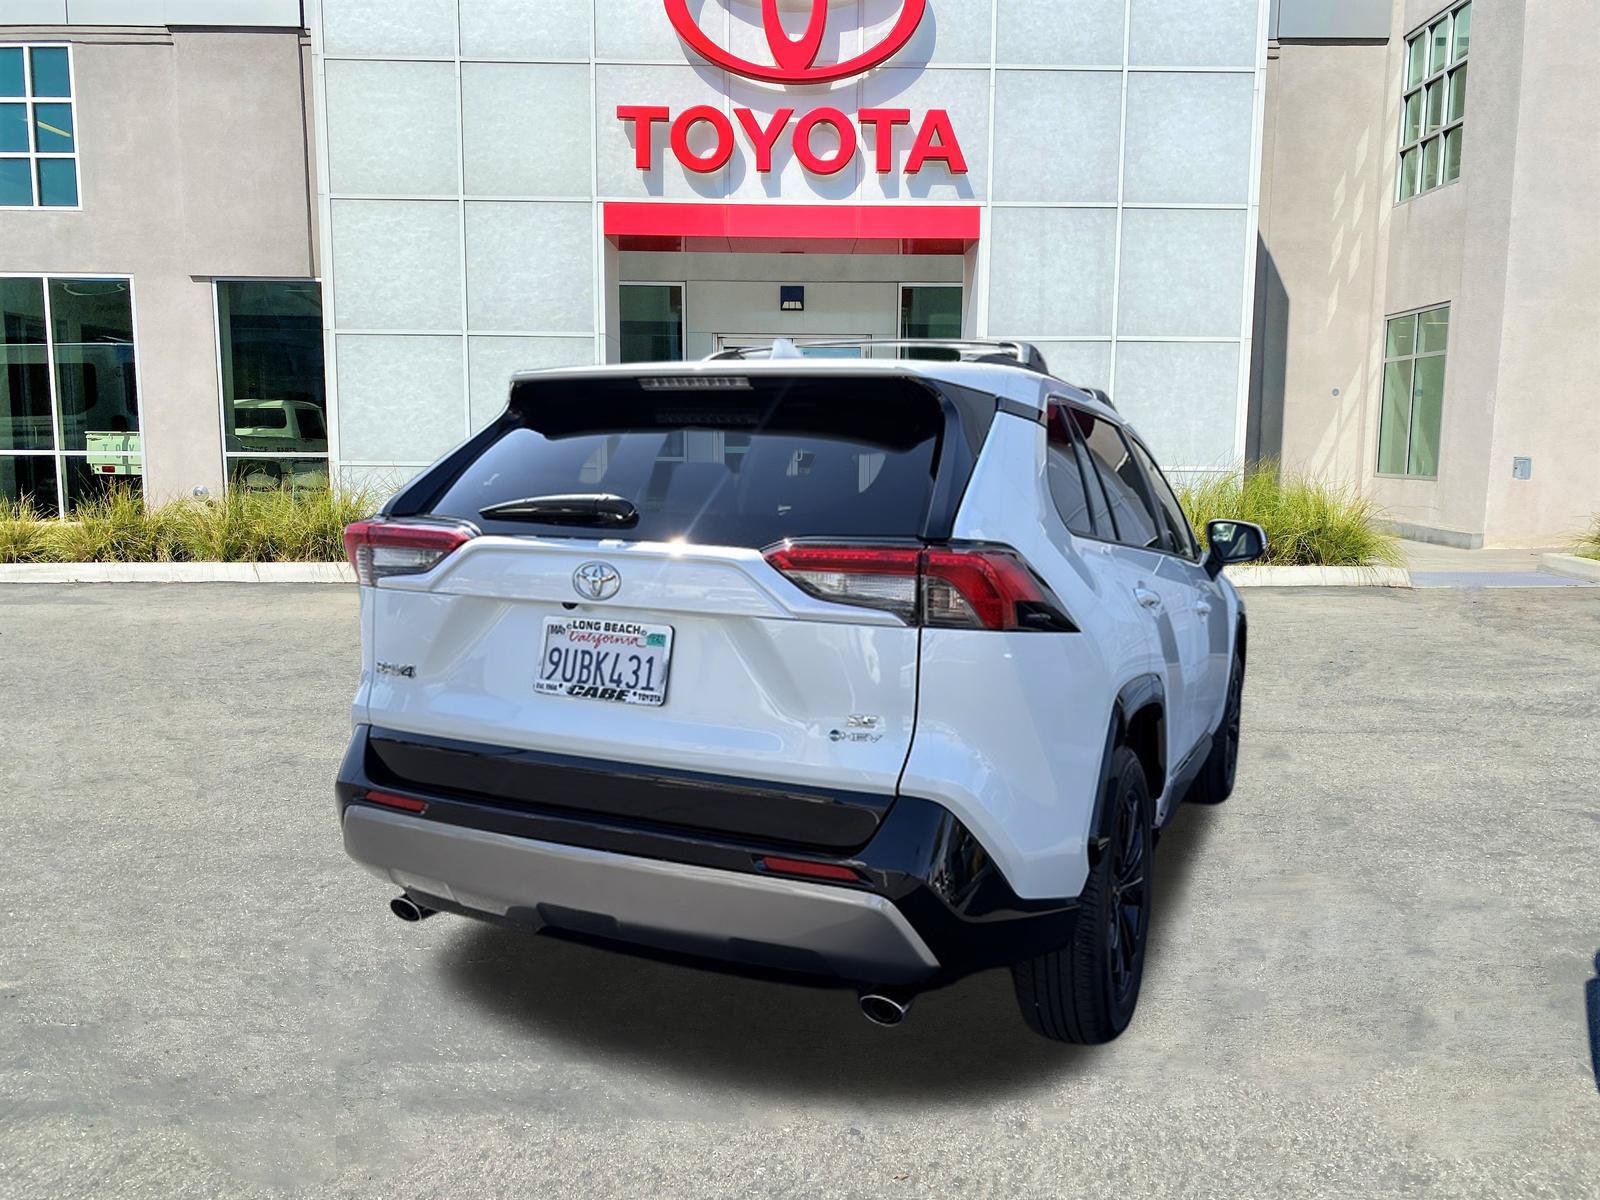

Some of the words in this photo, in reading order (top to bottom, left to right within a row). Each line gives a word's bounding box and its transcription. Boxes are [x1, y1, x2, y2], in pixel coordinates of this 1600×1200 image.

[617, 105, 968, 174] TOYOTA
[572, 620, 601, 631] LONG
[604, 622, 641, 634] BEACH
[569, 630, 647, 649] California
[545, 646, 655, 692] 9UBK431
[567, 684, 630, 702] CABE
